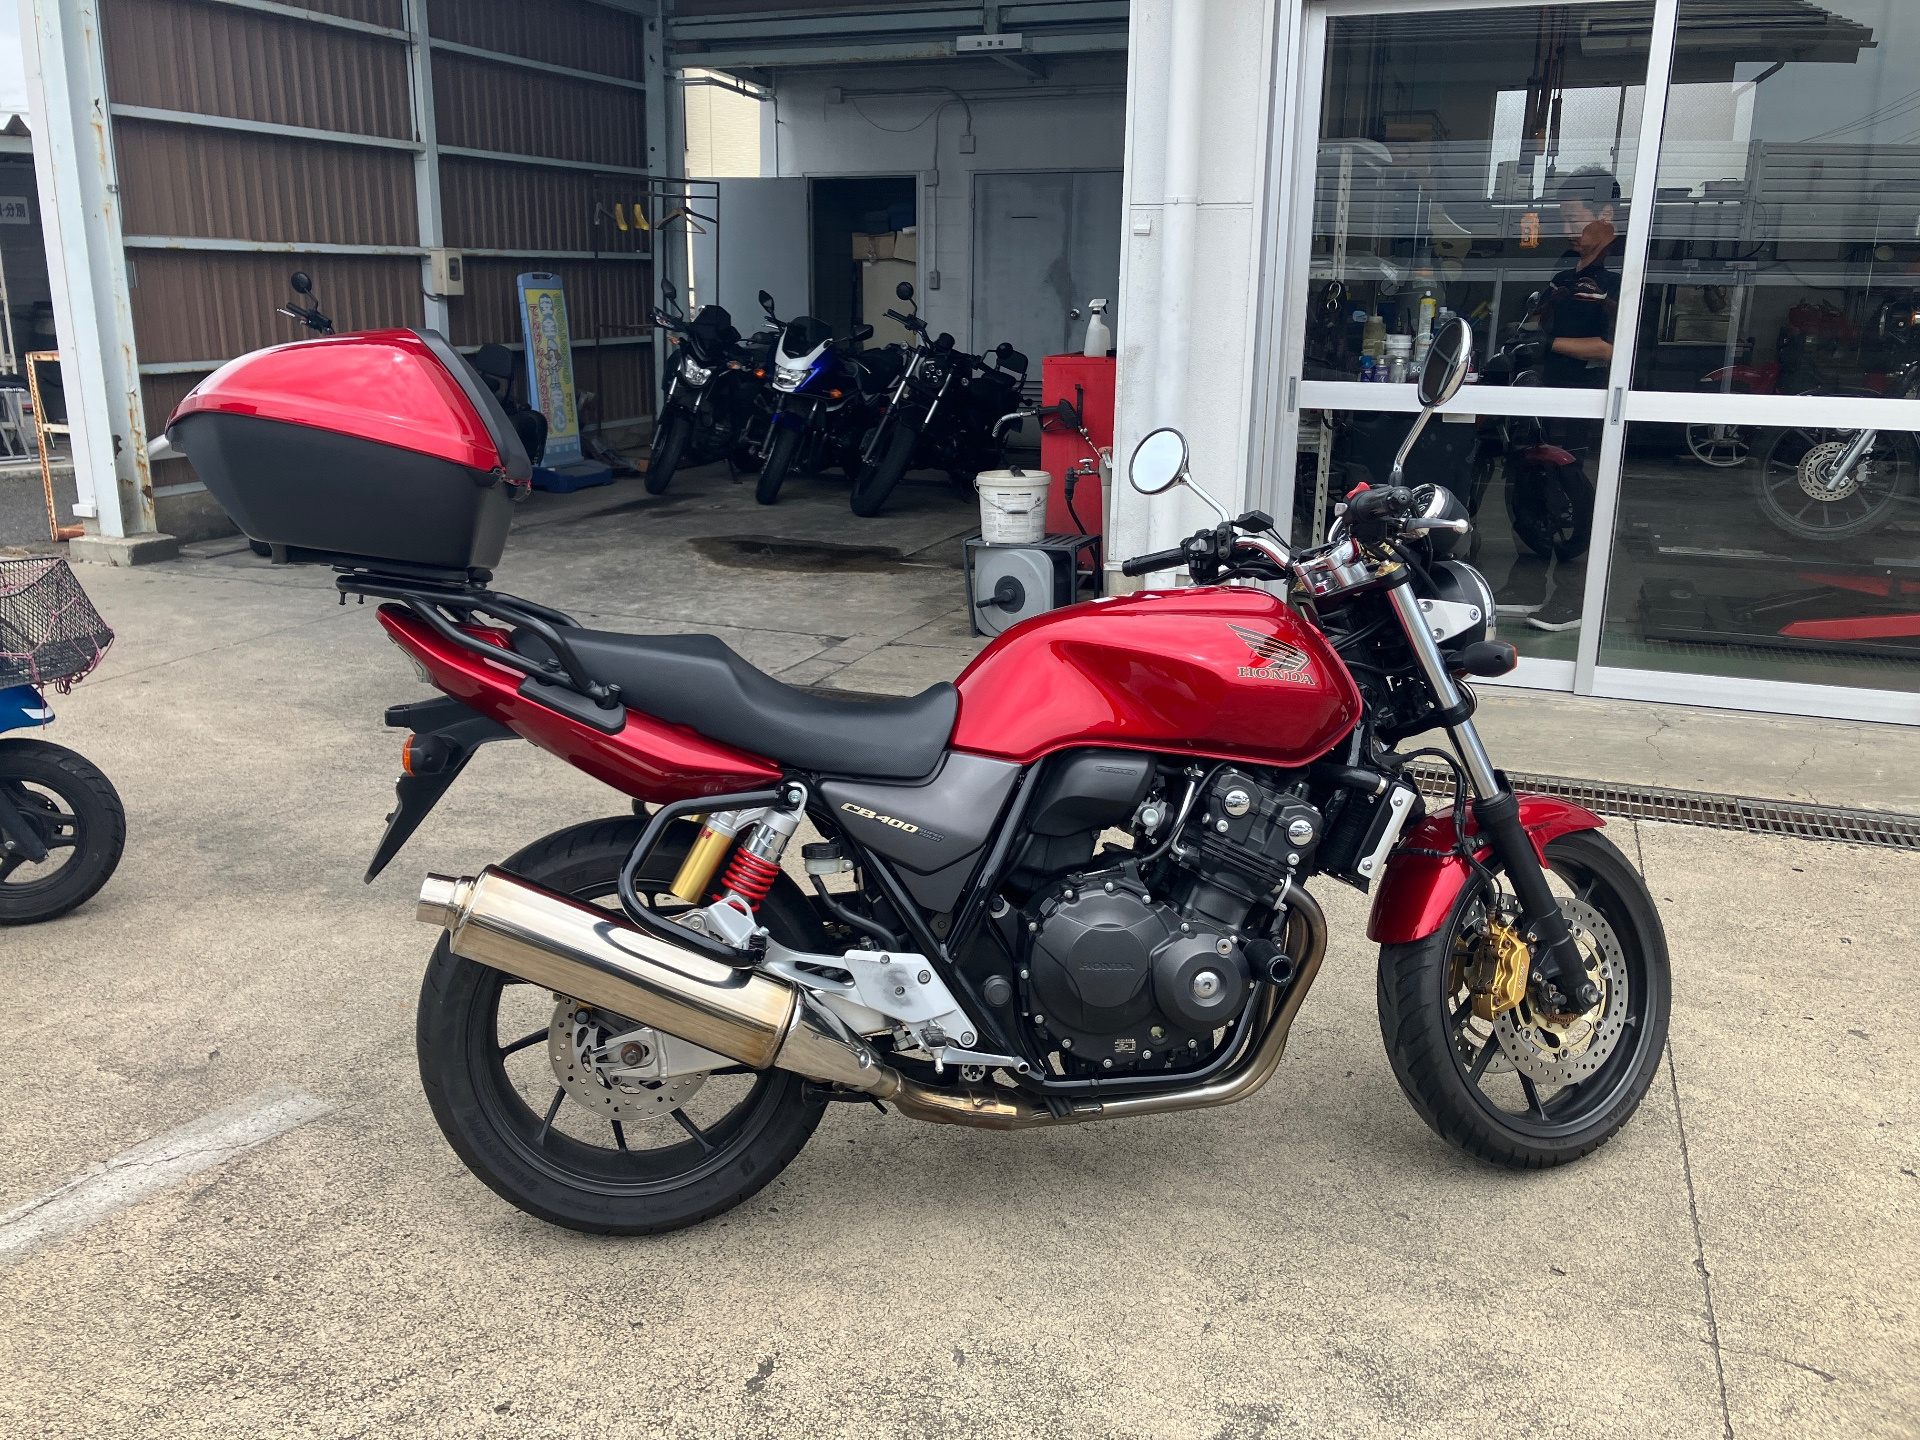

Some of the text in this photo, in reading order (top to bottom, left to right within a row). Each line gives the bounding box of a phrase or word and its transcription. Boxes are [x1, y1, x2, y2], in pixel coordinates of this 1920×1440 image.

[1237, 667, 1315, 685] HONDA
[841, 803, 918, 833] CB400
[1079, 962, 1135, 971] HONDA
